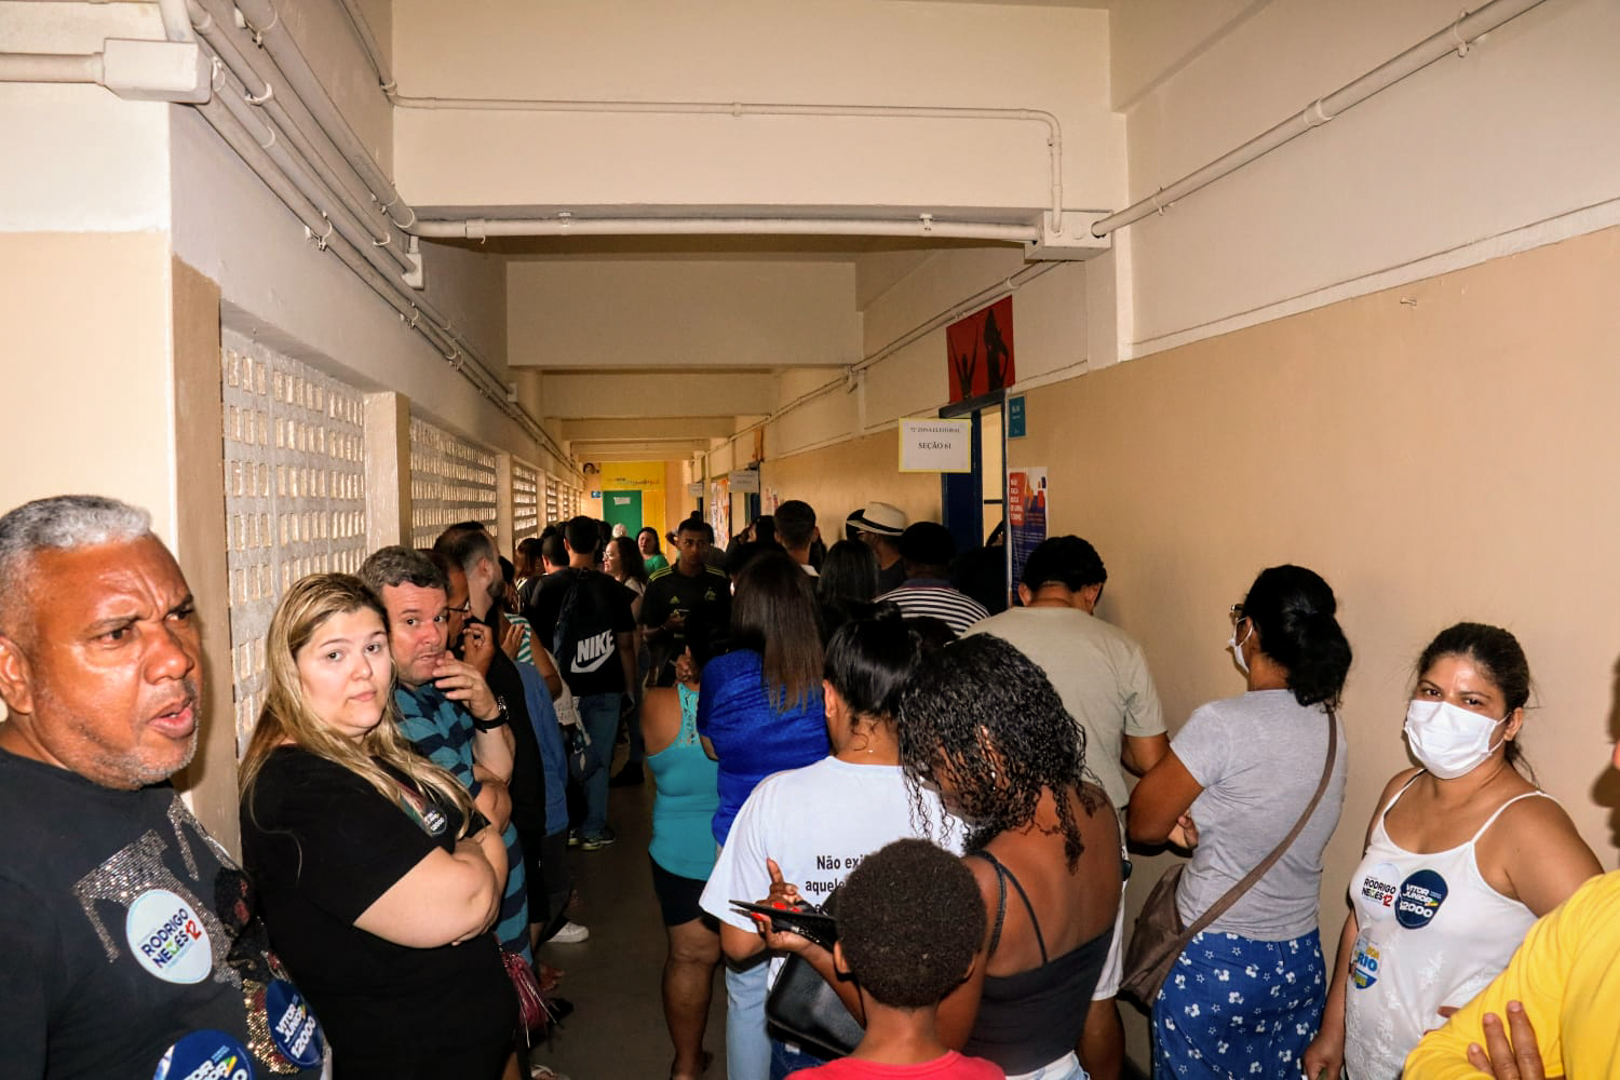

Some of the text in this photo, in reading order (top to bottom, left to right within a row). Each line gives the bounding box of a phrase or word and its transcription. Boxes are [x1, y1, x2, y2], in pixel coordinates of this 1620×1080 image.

[918, 441, 943, 450] SEÇÃO
[577, 629, 615, 663] NIKE
[817, 855, 841, 870] Não
[1363, 877, 1396, 895] RODRIGO
[141, 908, 188, 957] RODRIGO
[185, 919, 202, 940] 12
